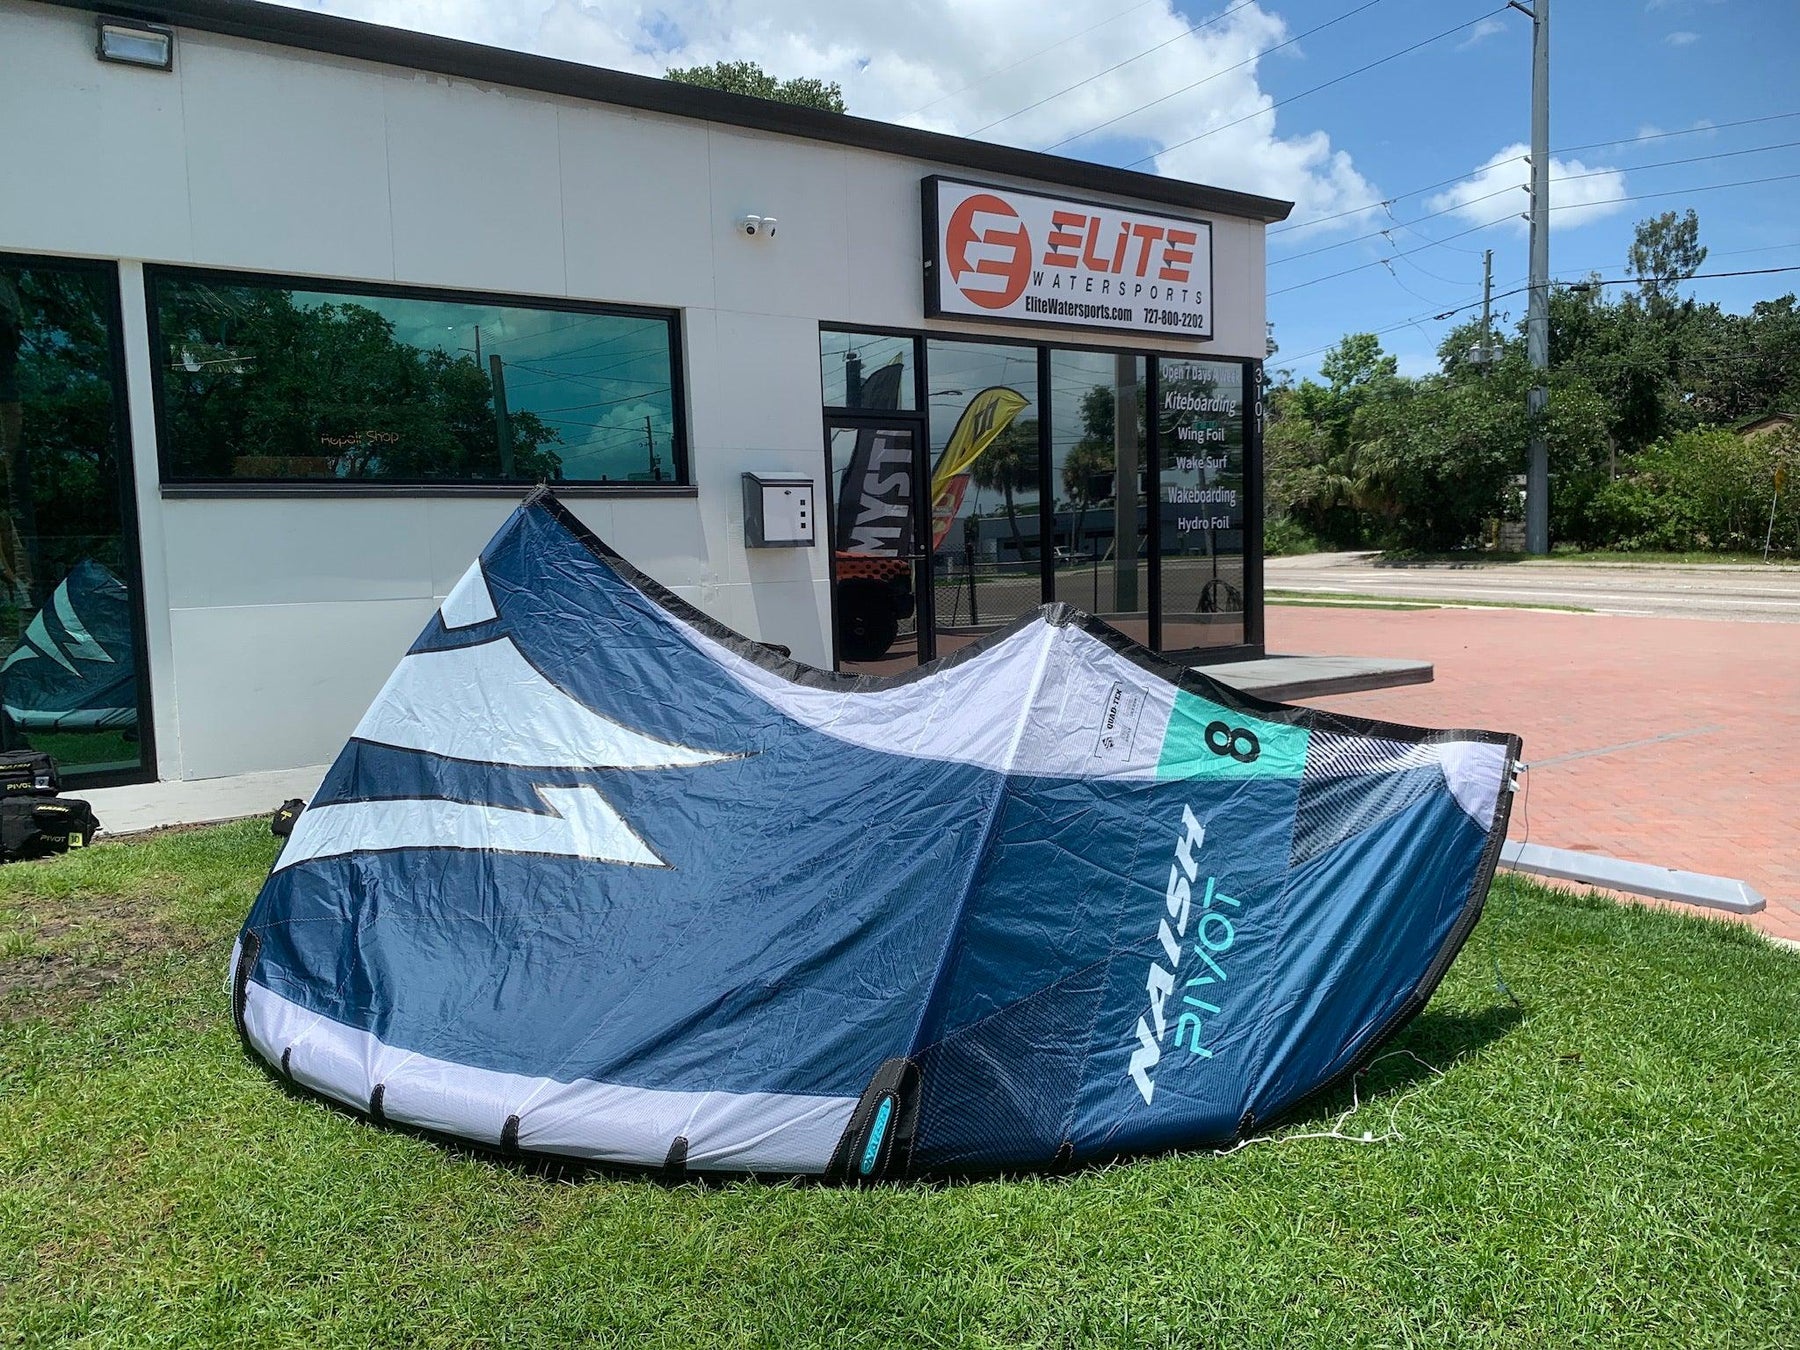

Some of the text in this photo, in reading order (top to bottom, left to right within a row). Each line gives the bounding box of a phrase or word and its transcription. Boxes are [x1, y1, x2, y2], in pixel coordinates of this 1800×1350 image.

[1033, 270, 1203, 304] WATERSPORTS
[1025, 296, 1204, 329] EliteWatersports.com 727-800-2202
[1162, 364, 1184, 382] Open
[1185, 366, 1191, 380] 7
[1192, 366, 1212, 384] Days
[1164, 390, 1237, 417] Kiteboarding
[1254, 368, 1263, 434] 3101
[366, 430, 399, 444] Shop
[1178, 427, 1225, 444] Wing Foil
[1176, 455, 1228, 469] Wake Surf
[1168, 486, 1236, 507] Wakeboarding
[1178, 516, 1230, 533] Hydro Foil
[1204, 720, 1261, 764] 8
[40, 834, 67, 843] PIVOT
[1174, 876, 1241, 1059] PIVOT
